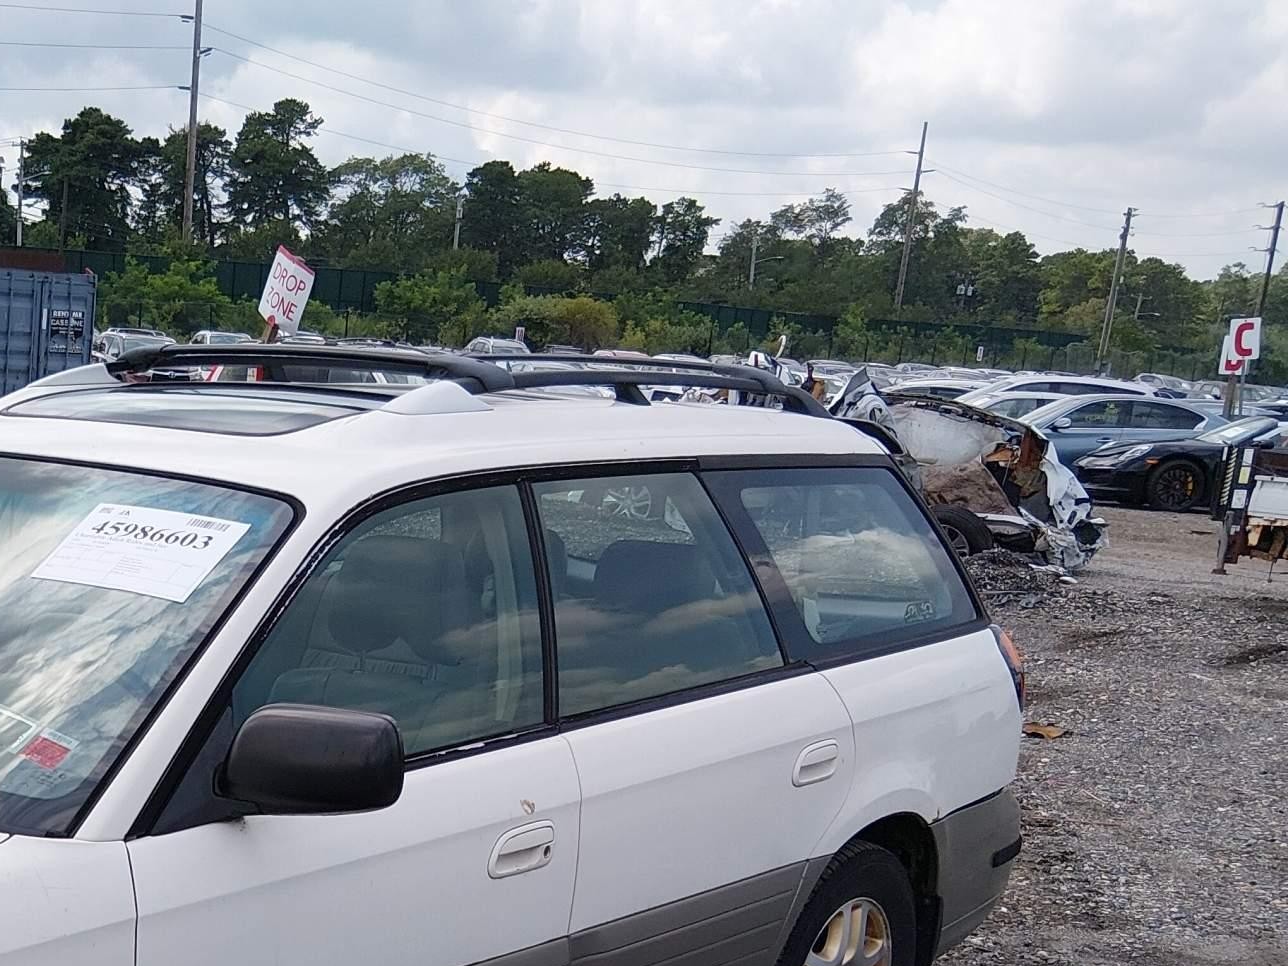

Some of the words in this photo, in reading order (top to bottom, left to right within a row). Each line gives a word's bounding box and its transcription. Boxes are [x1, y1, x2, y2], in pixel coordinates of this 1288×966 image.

[273, 262, 306, 296] DROP
[1234, 322, 1255, 357] C
[91, 520, 214, 550] 45986603
